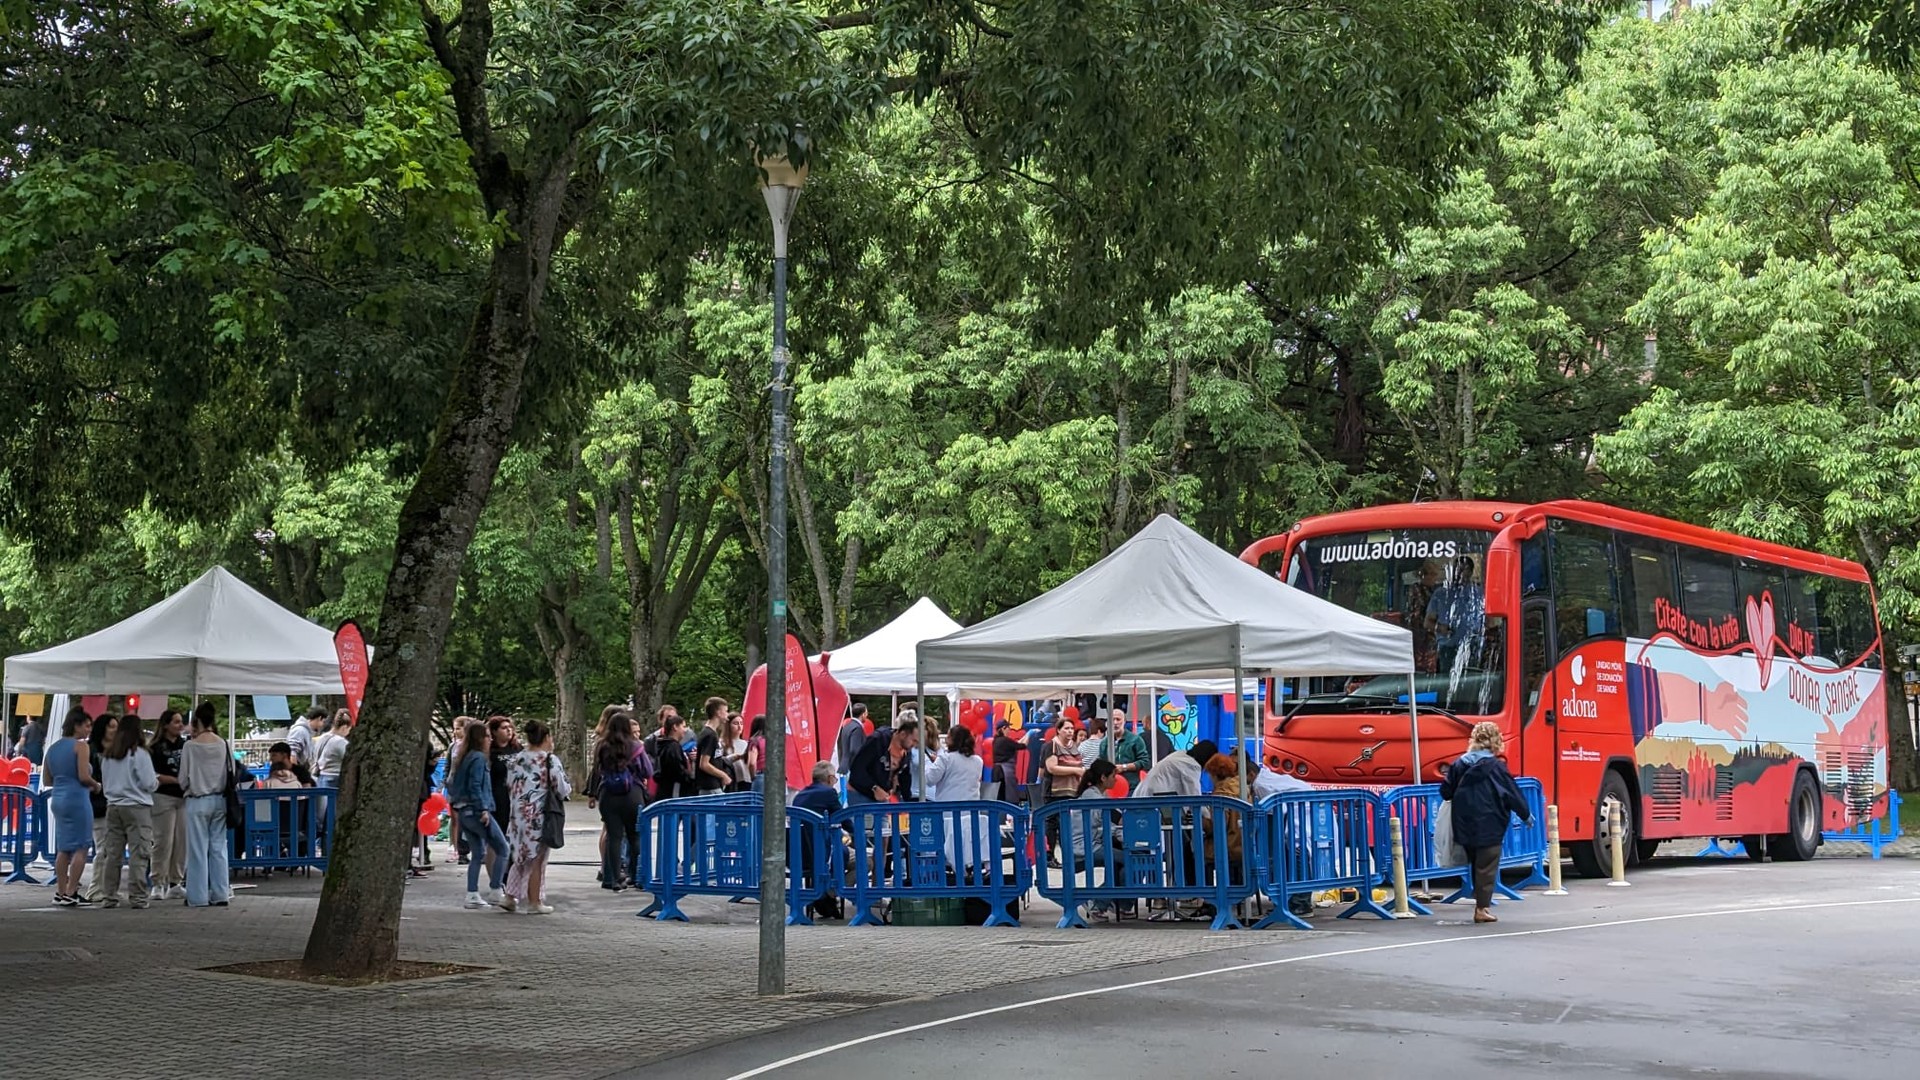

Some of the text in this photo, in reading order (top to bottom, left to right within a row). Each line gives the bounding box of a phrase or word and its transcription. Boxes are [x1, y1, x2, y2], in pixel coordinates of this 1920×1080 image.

[1321, 537, 1456, 564] www.adona.es
[1655, 597, 1740, 649] Cítate con la vida
[1562, 688, 1598, 718] adona
[1789, 665, 1860, 716] DONAR SANGRE
